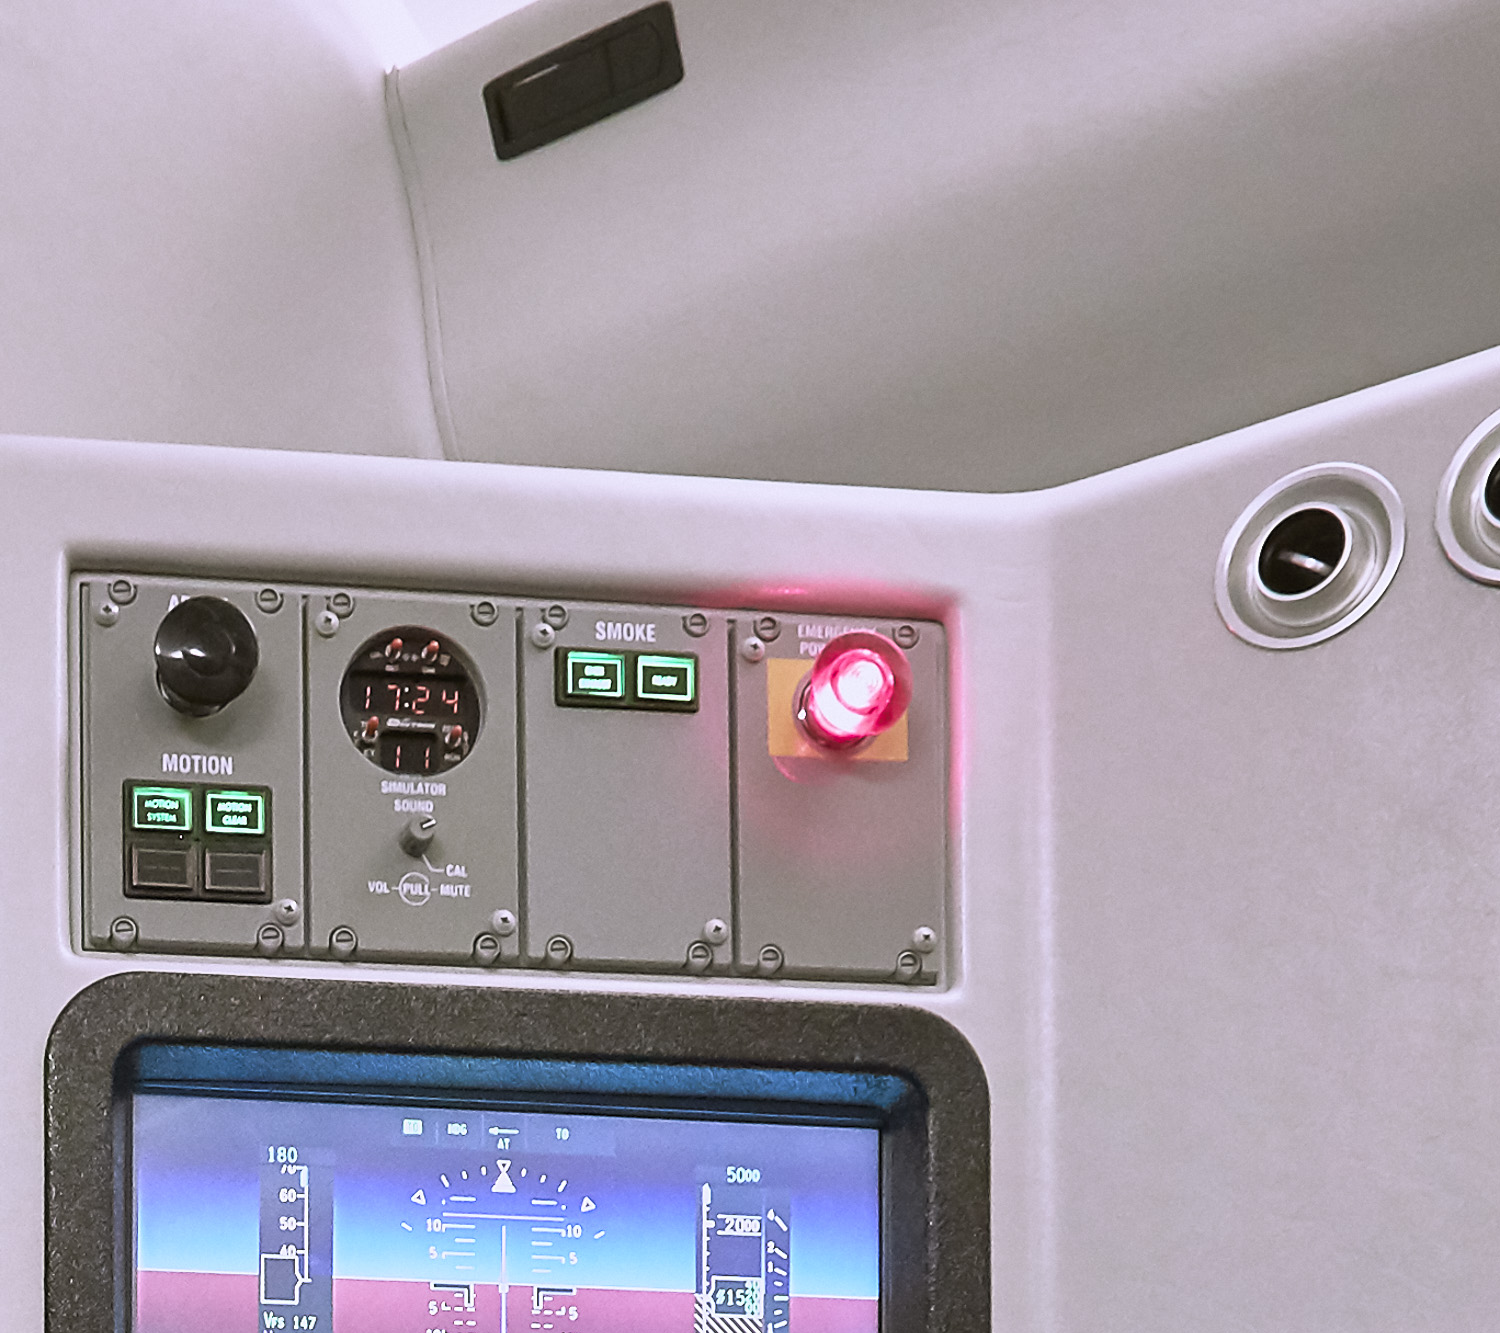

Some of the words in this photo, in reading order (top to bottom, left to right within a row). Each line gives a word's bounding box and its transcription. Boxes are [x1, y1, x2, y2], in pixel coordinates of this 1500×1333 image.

[595, 621, 656, 643] SMOKE
[365, 685, 459, 714] 17:24
[162, 753, 233, 776] MOTION
[381, 780, 446, 796] SIMULATOR
[394, 799, 433, 813] SOUND
[446, 864, 467, 877] CAL
[368, 881, 390, 894] VOL
[402, 883, 430, 896] PULL
[440, 884, 471, 897] MUTE
[268, 1146, 298, 1164] 180
[726, 1166, 761, 1184] 5000
[725, 1218, 760, 1233] 2000
[293, 1316, 316, 1330] 147
